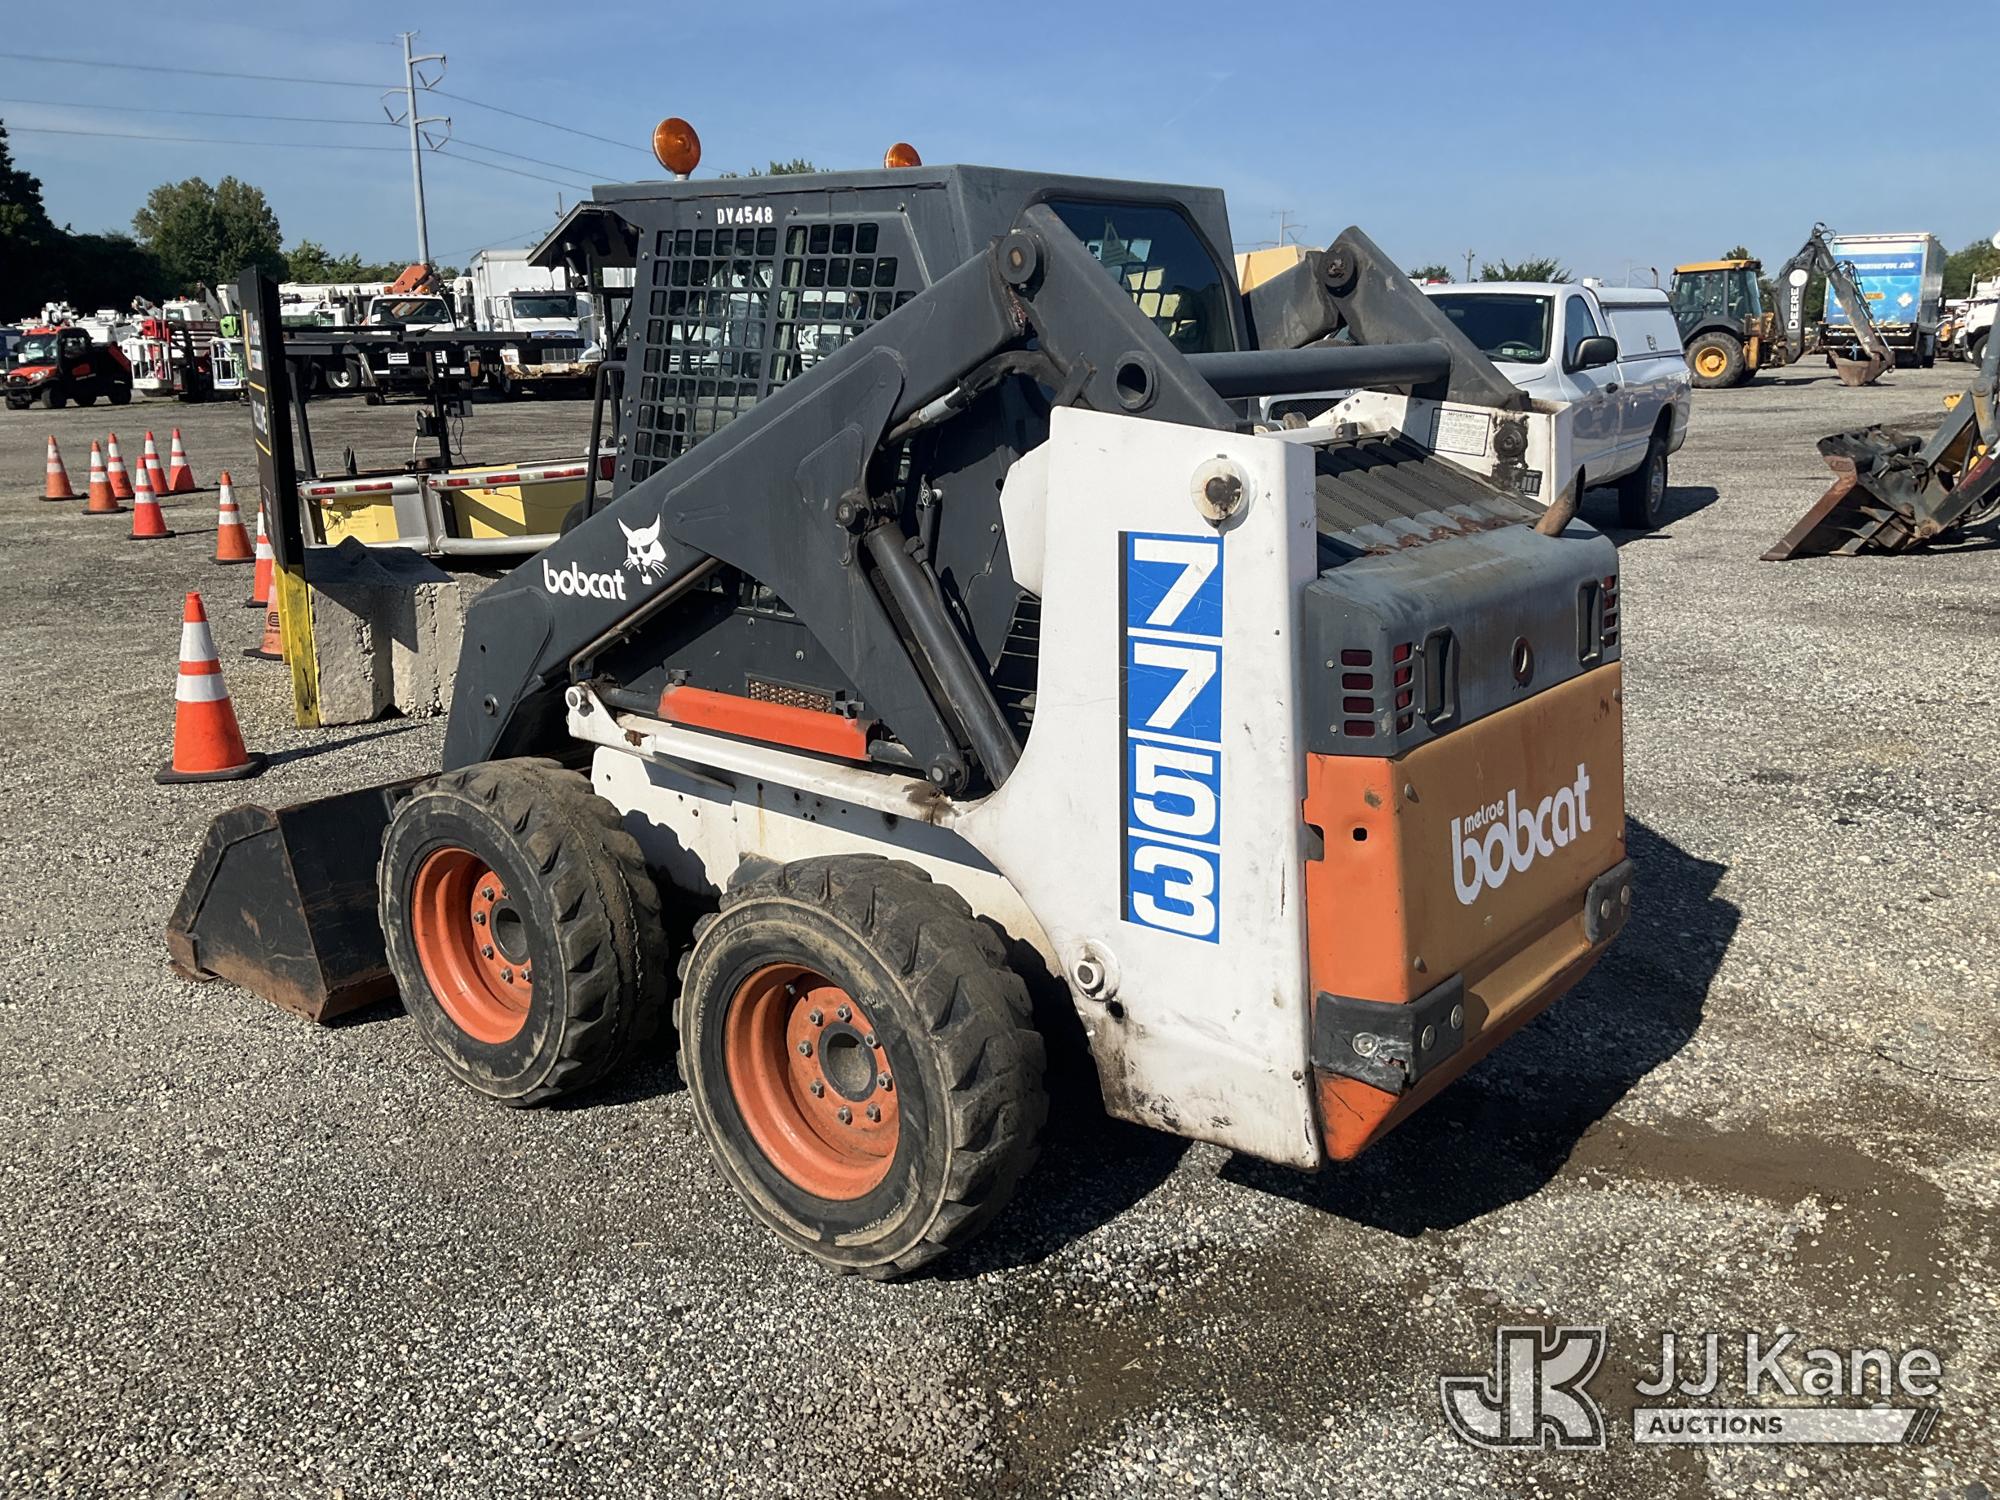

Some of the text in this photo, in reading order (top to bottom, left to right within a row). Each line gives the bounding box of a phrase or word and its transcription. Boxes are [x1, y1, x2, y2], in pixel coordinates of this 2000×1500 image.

[717, 206, 773, 225] DV4548
[1788, 287, 1800, 329] DEERE
[543, 559, 626, 600] bobcat
[1133, 538, 1219, 937] 7753
[1451, 763, 1591, 905] bobcat
